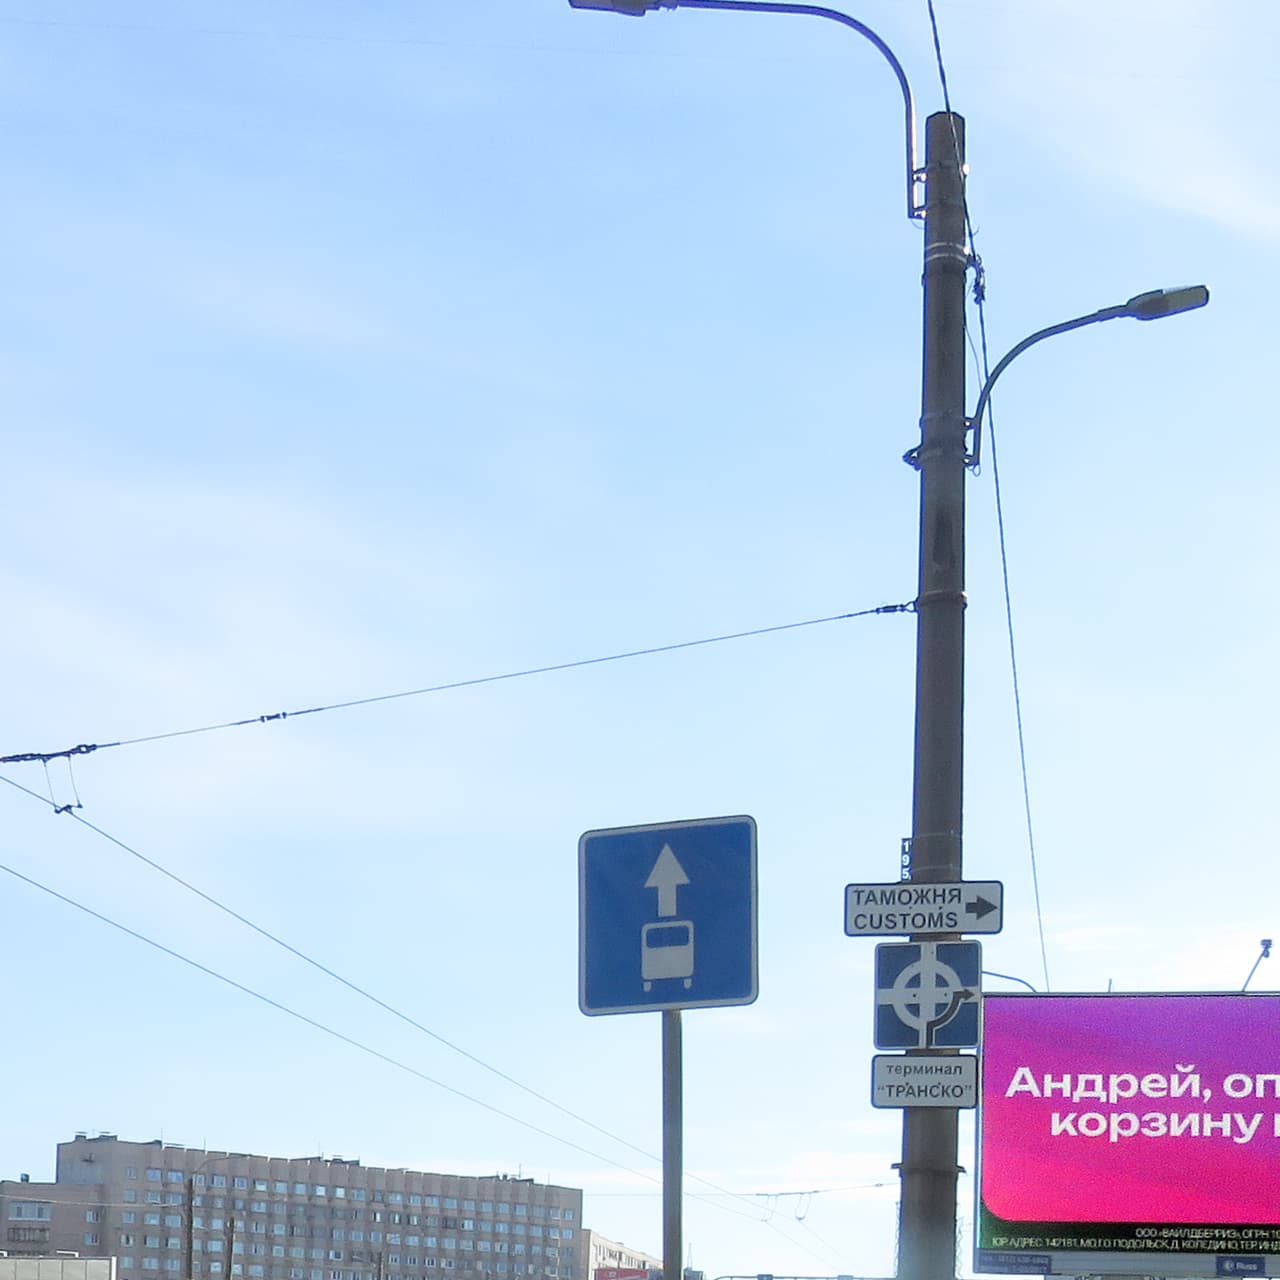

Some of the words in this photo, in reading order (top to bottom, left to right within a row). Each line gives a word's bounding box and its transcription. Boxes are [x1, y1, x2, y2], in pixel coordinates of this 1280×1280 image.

[853, 887, 962, 906] ТАМОЖНЯ
[853, 911, 959, 930] CUSTOMS
[886, 1064, 962, 1078] терминал
[1004, 1063, 1212, 1104] Андрей,
[1051, 1109, 1263, 1144] корзину
[1135, 1227, 1157, 1238] ООО
[1242, 1228, 1269, 1240] ОГРН
